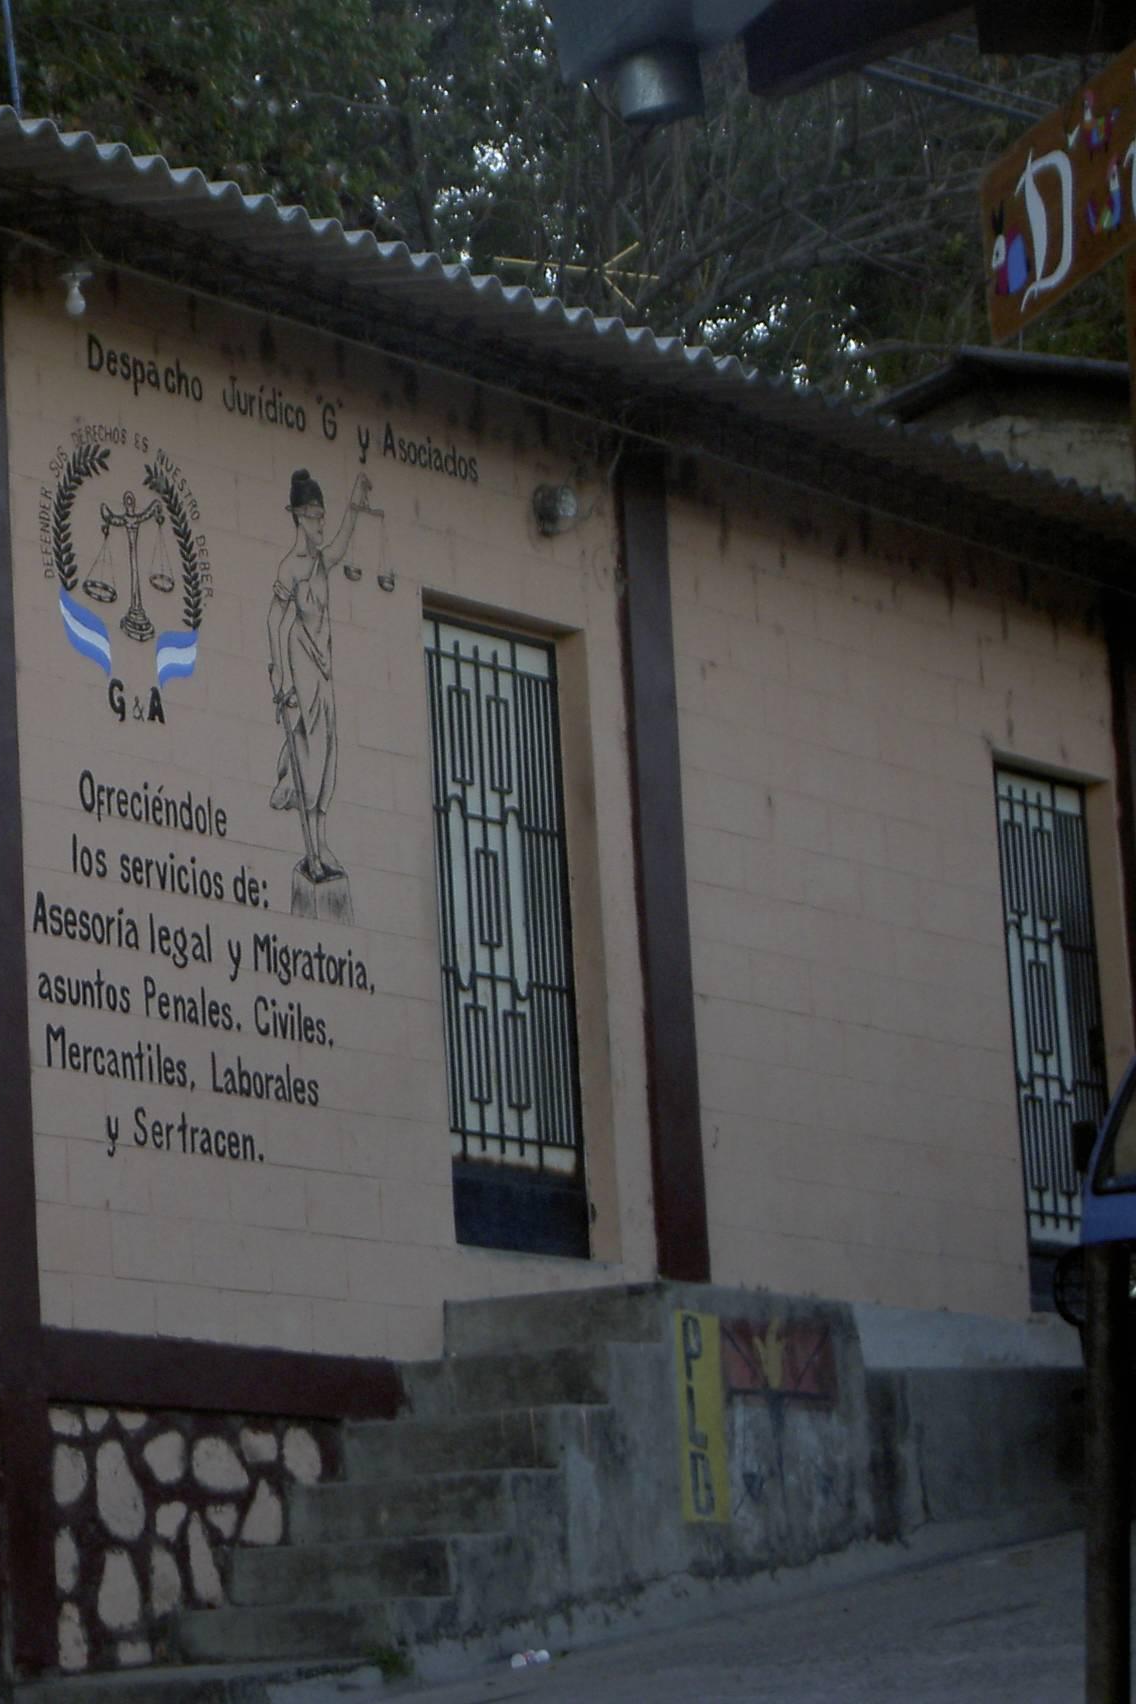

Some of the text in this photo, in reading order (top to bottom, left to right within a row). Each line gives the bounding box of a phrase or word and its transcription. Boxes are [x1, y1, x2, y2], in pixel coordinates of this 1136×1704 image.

[87, 333, 204, 402] Despacho
[222, 375, 306, 432] Jurídico
[357, 424, 370, 465] y
[383, 421, 480, 483] Asociados
[38, 486, 54, 579] DEFENDER
[49, 445, 69, 478] SUS
[70, 424, 128, 448] DERECHOS
[134, 433, 150, 454] ES
[156, 448, 201, 521] NUESTRO
[72, 833, 270, 909] los servicios de:
[37, 968, 131, 1014] asuntos
[149, 913, 213, 968] legal
[227, 936, 242, 982] y
[253, 933, 376, 995] Migratoria,
[46, 1023, 320, 1107] Mercantiles, Laborales
[107, 1106, 266, 1163] y Sertracen.
